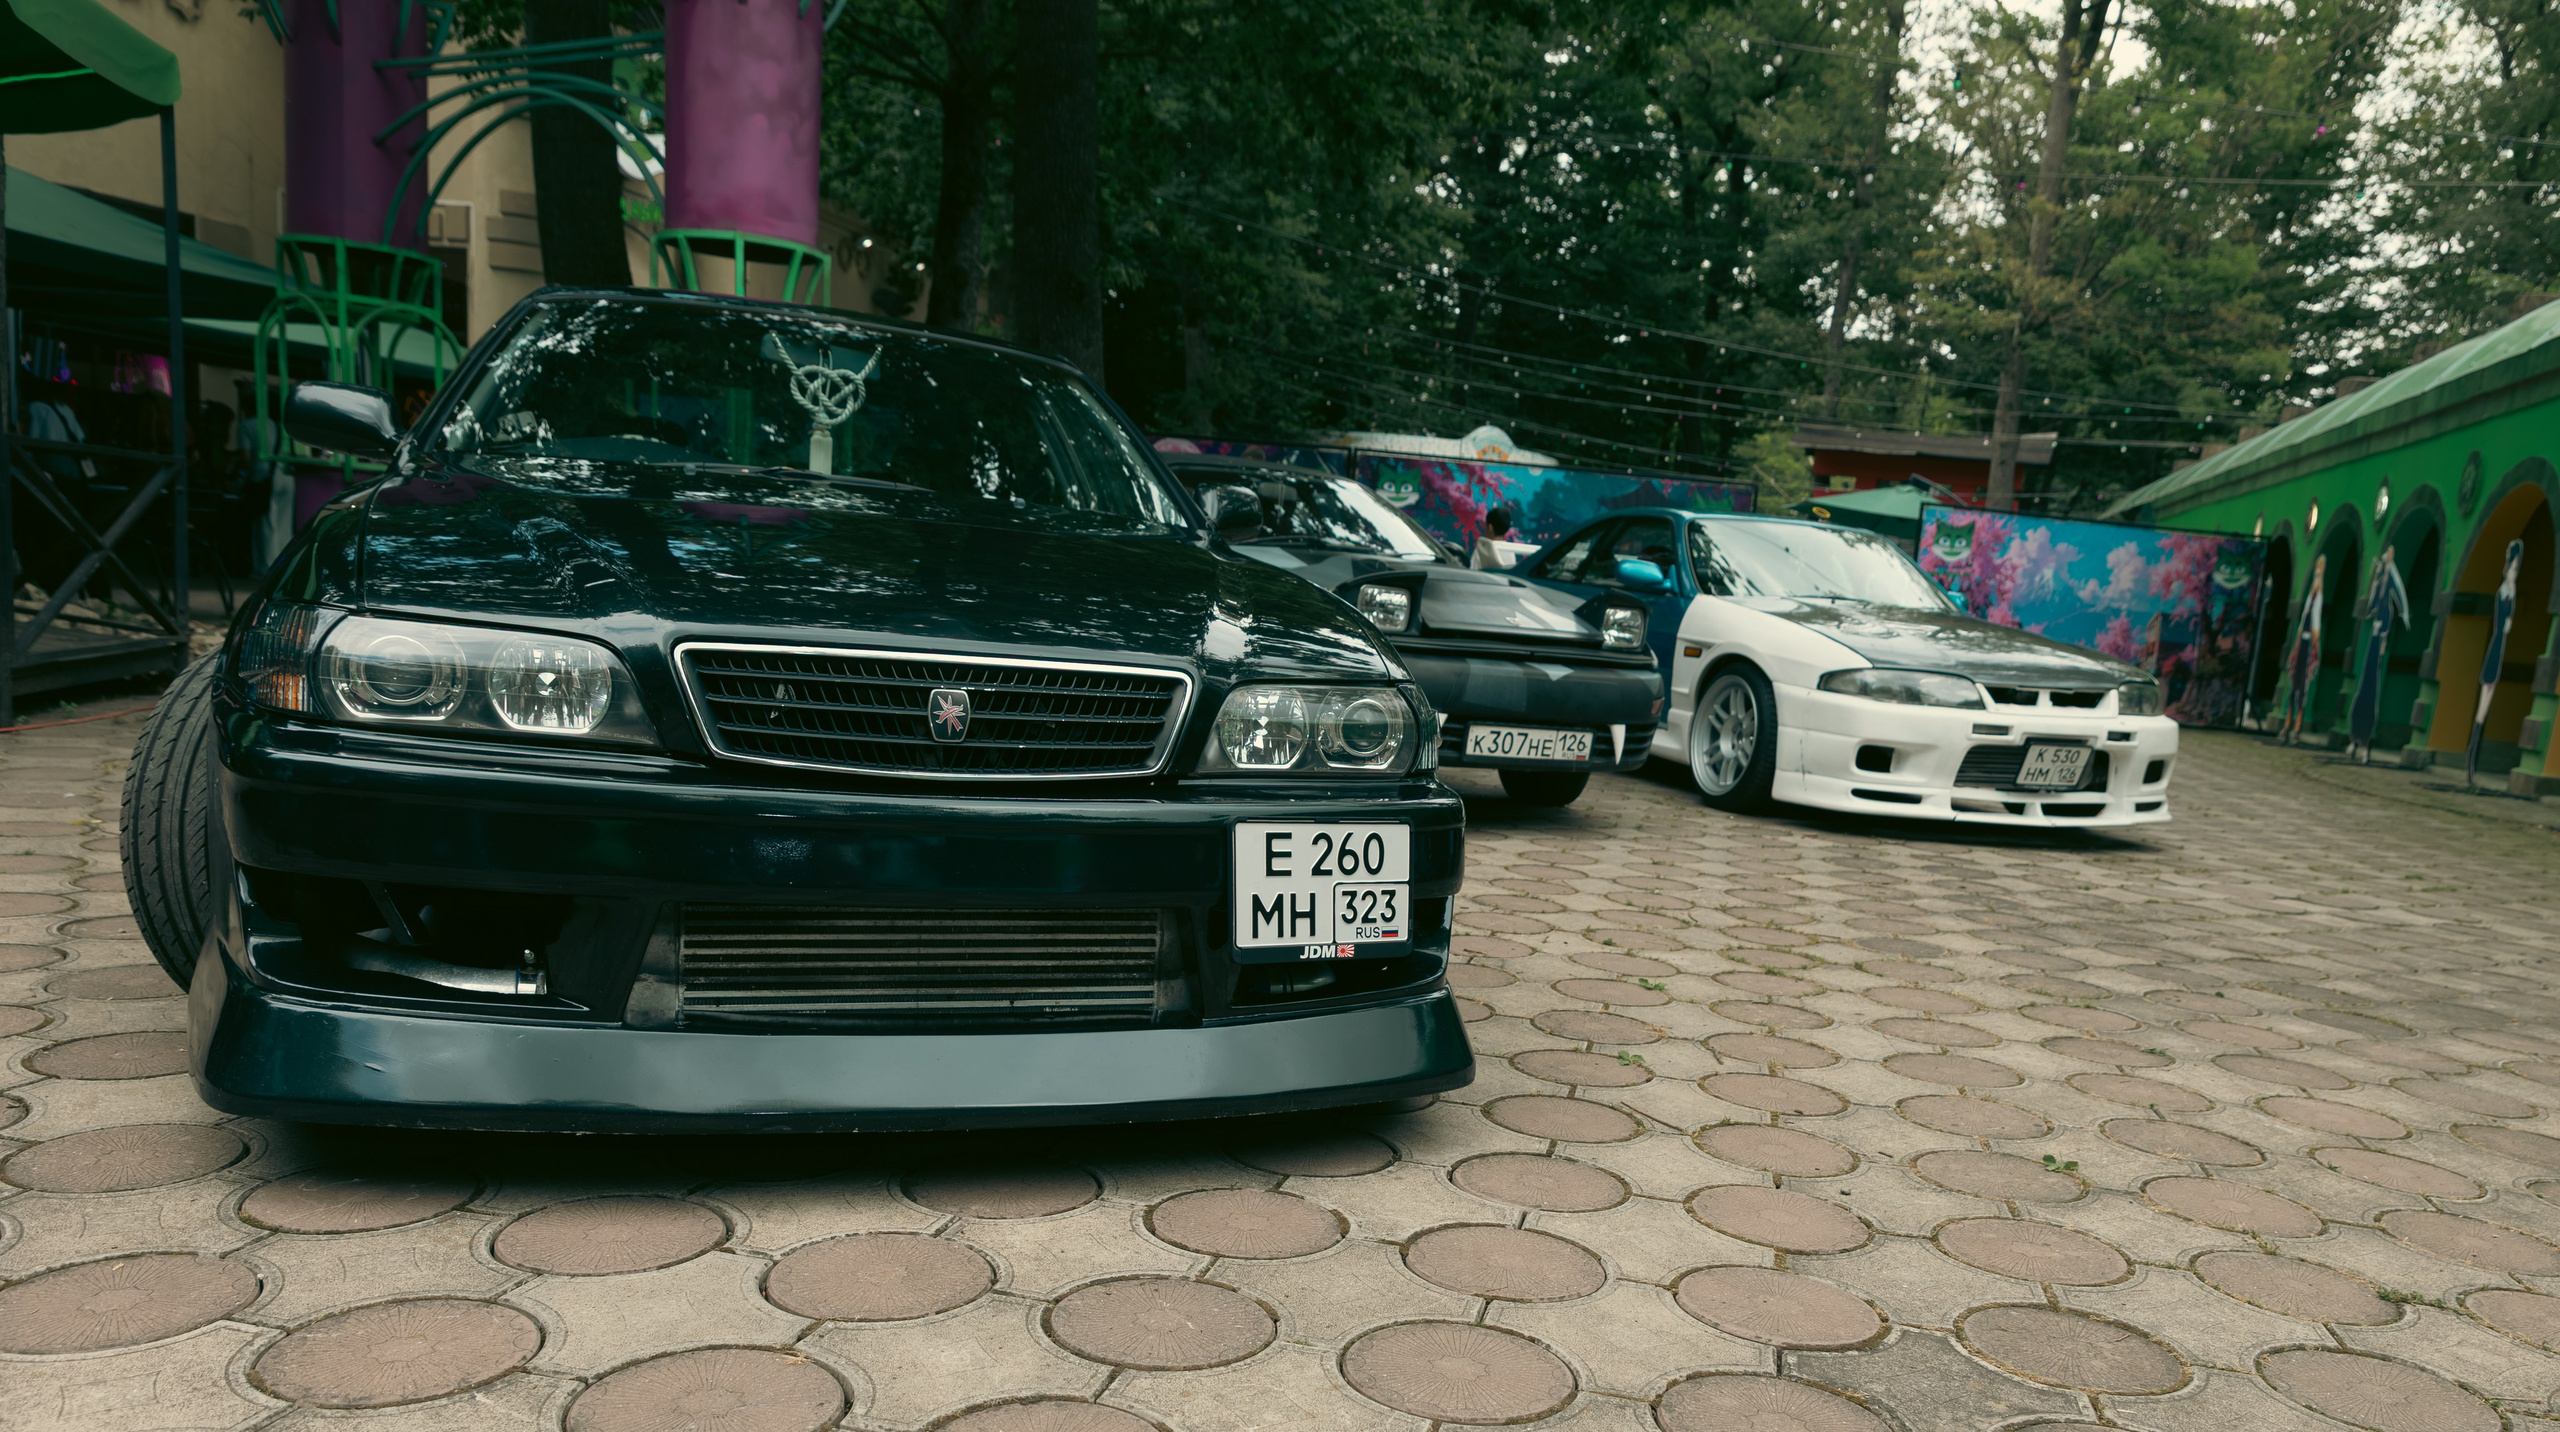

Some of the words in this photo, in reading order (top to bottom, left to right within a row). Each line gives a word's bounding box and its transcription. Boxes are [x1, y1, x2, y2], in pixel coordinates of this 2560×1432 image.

[1559, 733, 1587, 752] 126
[2035, 748, 2048, 762] K
[2051, 749, 2080, 764] 530
[2024, 767, 2050, 782] HM
[2057, 768, 2076, 779] 126
[1266, 832, 1292, 877] E
[1311, 831, 1384, 876] 260
[1252, 893, 1315, 939] MH
[1341, 889, 1397, 924] 323
[1355, 927, 1380, 939] RUS
[1300, 945, 1336, 959] JDM
